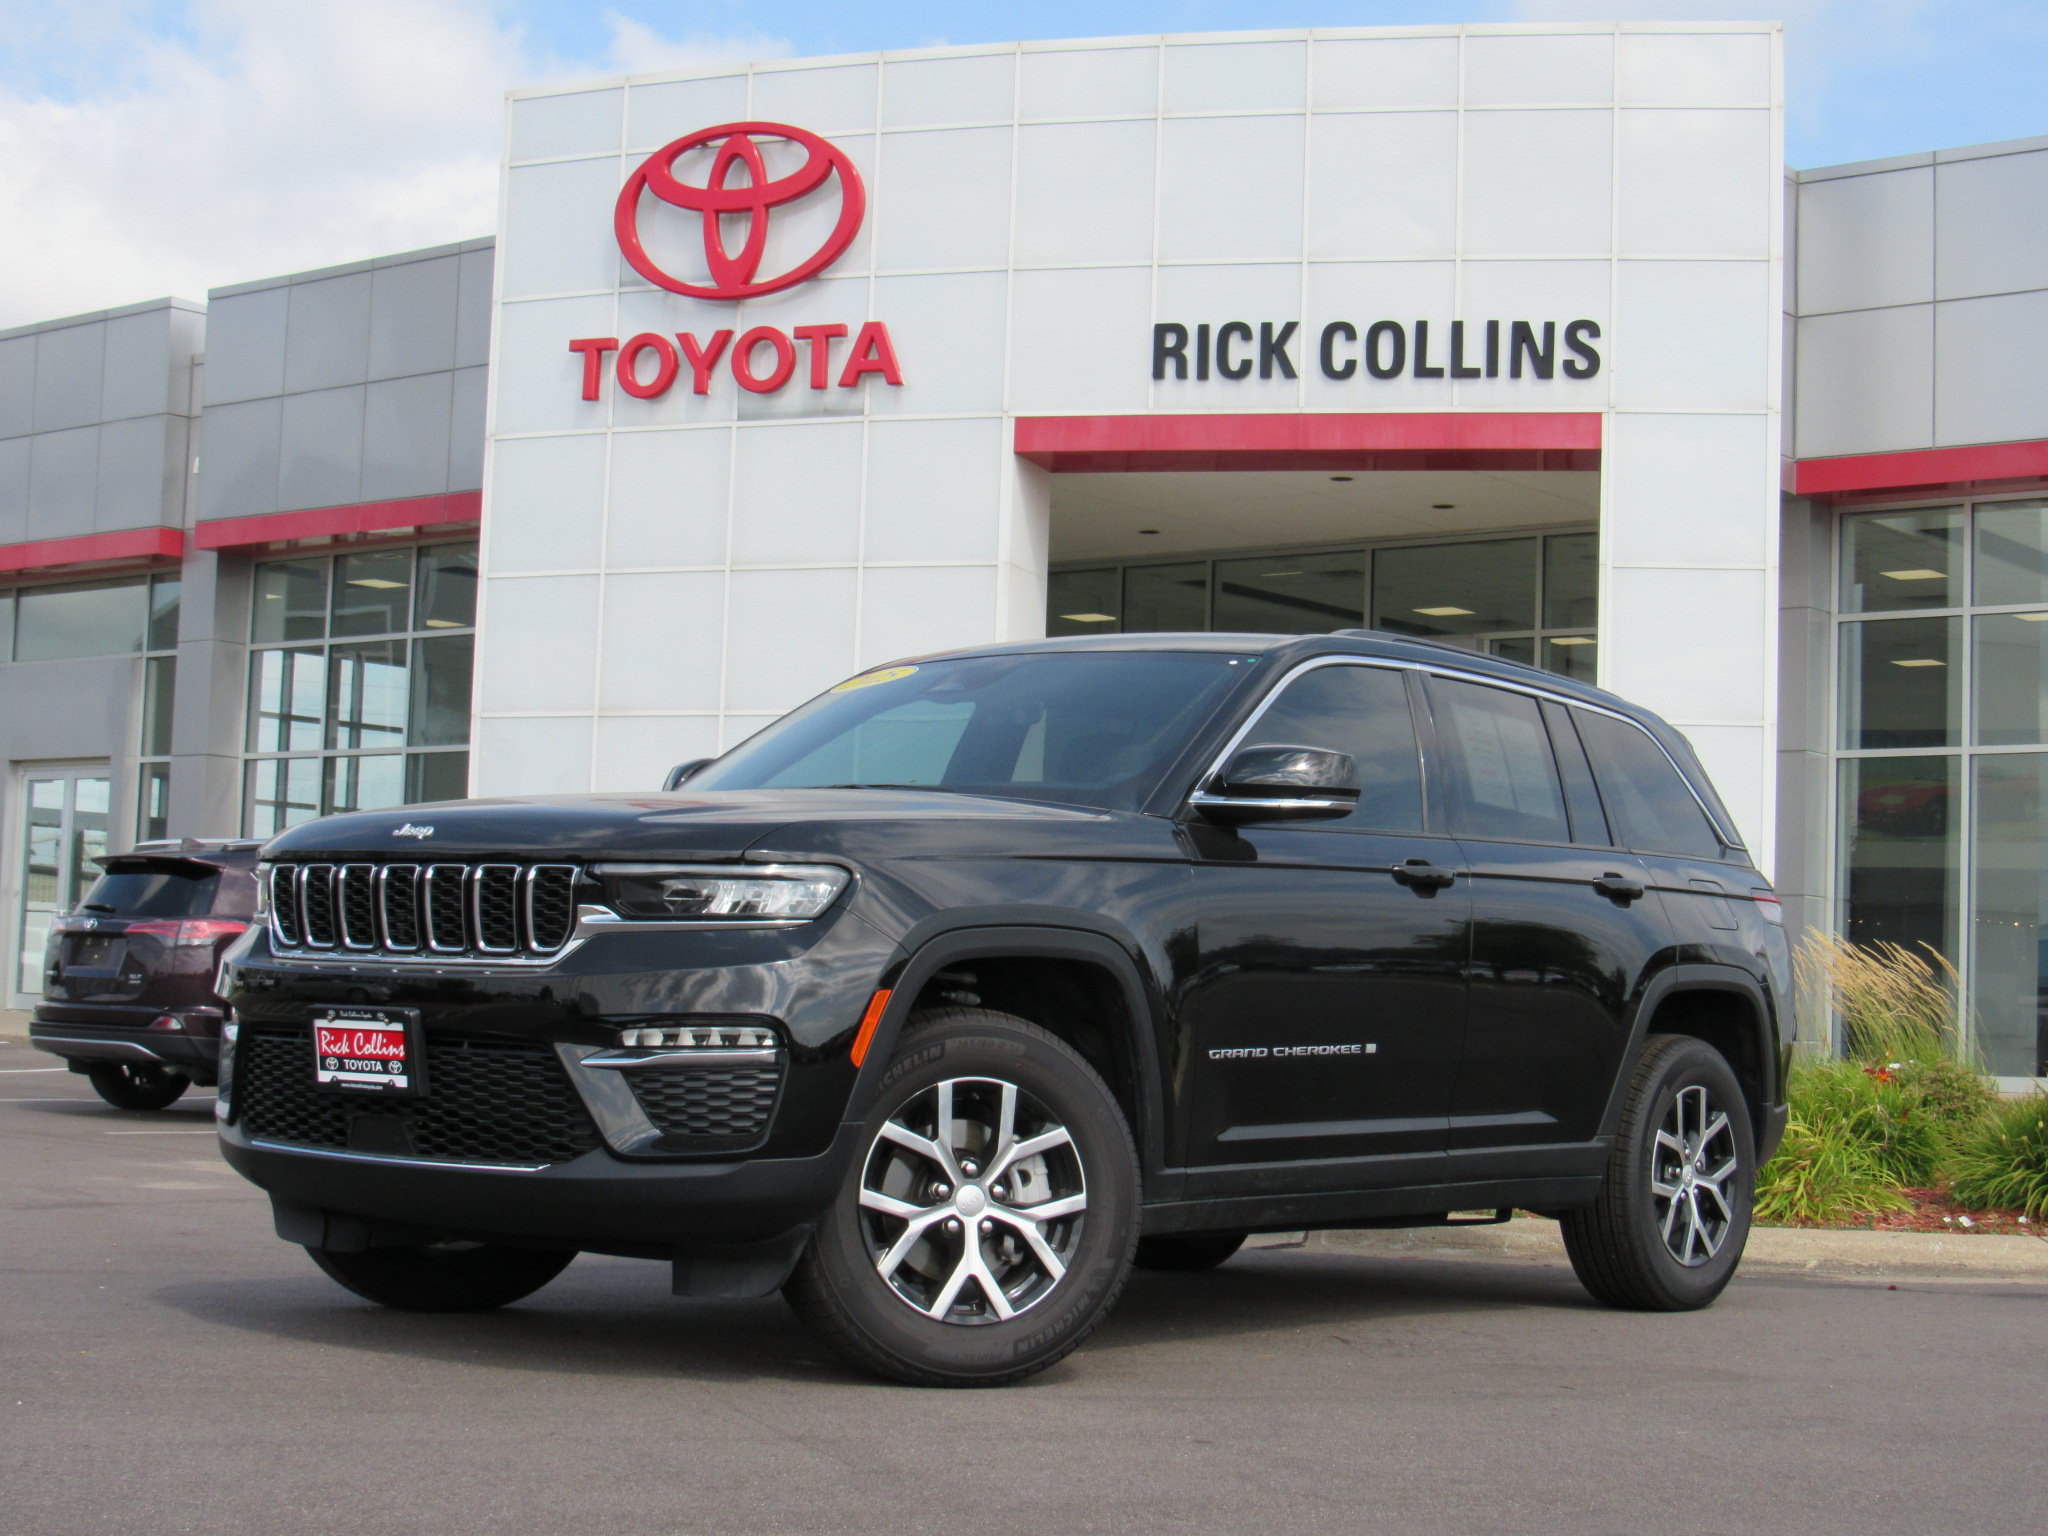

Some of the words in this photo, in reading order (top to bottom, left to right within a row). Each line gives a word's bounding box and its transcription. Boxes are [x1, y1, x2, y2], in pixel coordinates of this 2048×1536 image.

[1152, 321, 1300, 381] RICK
[1319, 319, 1602, 381] COLLINS
[569, 321, 905, 402] TOYOTA
[392, 823, 435, 840] Jeep
[321, 1030, 351, 1055] Rick
[353, 1031, 406, 1058] Collins
[1208, 1047, 1269, 1060] GRAND
[1272, 1044, 1362, 1057] CHEROKEE
[343, 1059, 384, 1072] TOYOTA
